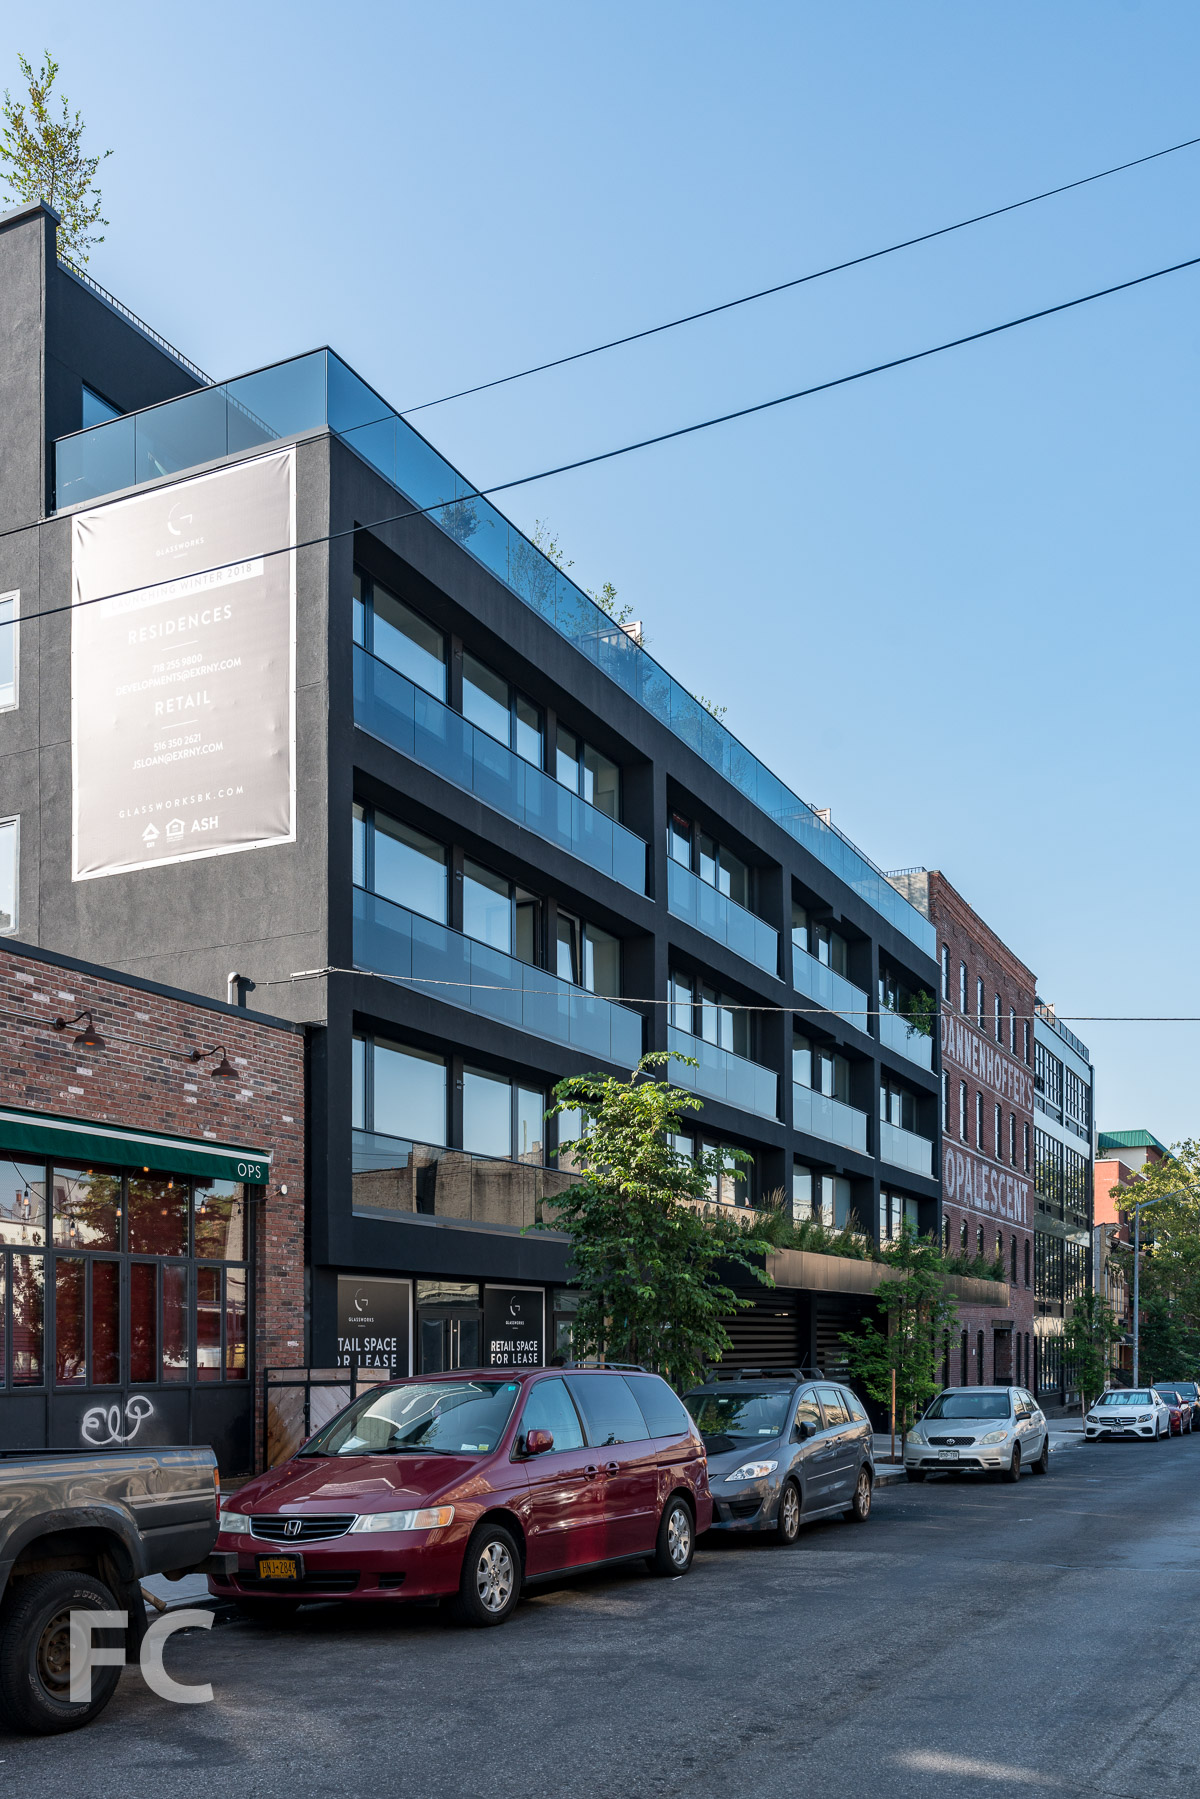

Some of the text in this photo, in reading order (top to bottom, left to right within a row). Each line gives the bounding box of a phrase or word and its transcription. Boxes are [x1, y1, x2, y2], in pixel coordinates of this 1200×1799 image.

[155, 537, 205, 557] GLASSWORKS
[111, 563, 253, 610] LAUNCHING WINTER 2018
[128, 604, 233, 645] RESIDENCES
[152, 653, 203, 673] 718 255 9800
[115, 657, 242, 696] DEVELOPMENTS@EXRNY.COM
[155, 690, 211, 716] RETAIL
[153, 733, 202, 752] 516 350 2621
[132, 741, 224, 770] JSLOAN@EXRNY.COM
[119, 785, 245, 818] GLASSWORKSBK.COM
[190, 815, 219, 833] ASH
[941, 1010, 1033, 1111] DANNENHOFFER'S
[237, 1162, 262, 1180] OPS
[945, 1148, 1029, 1224] OPALESCENT
[337, 1337, 397, 1352] TAIL SPACE
[490, 1340, 538, 1352] RETAIL SPACE
[490, 1353, 538, 1365] FOR LEASE
